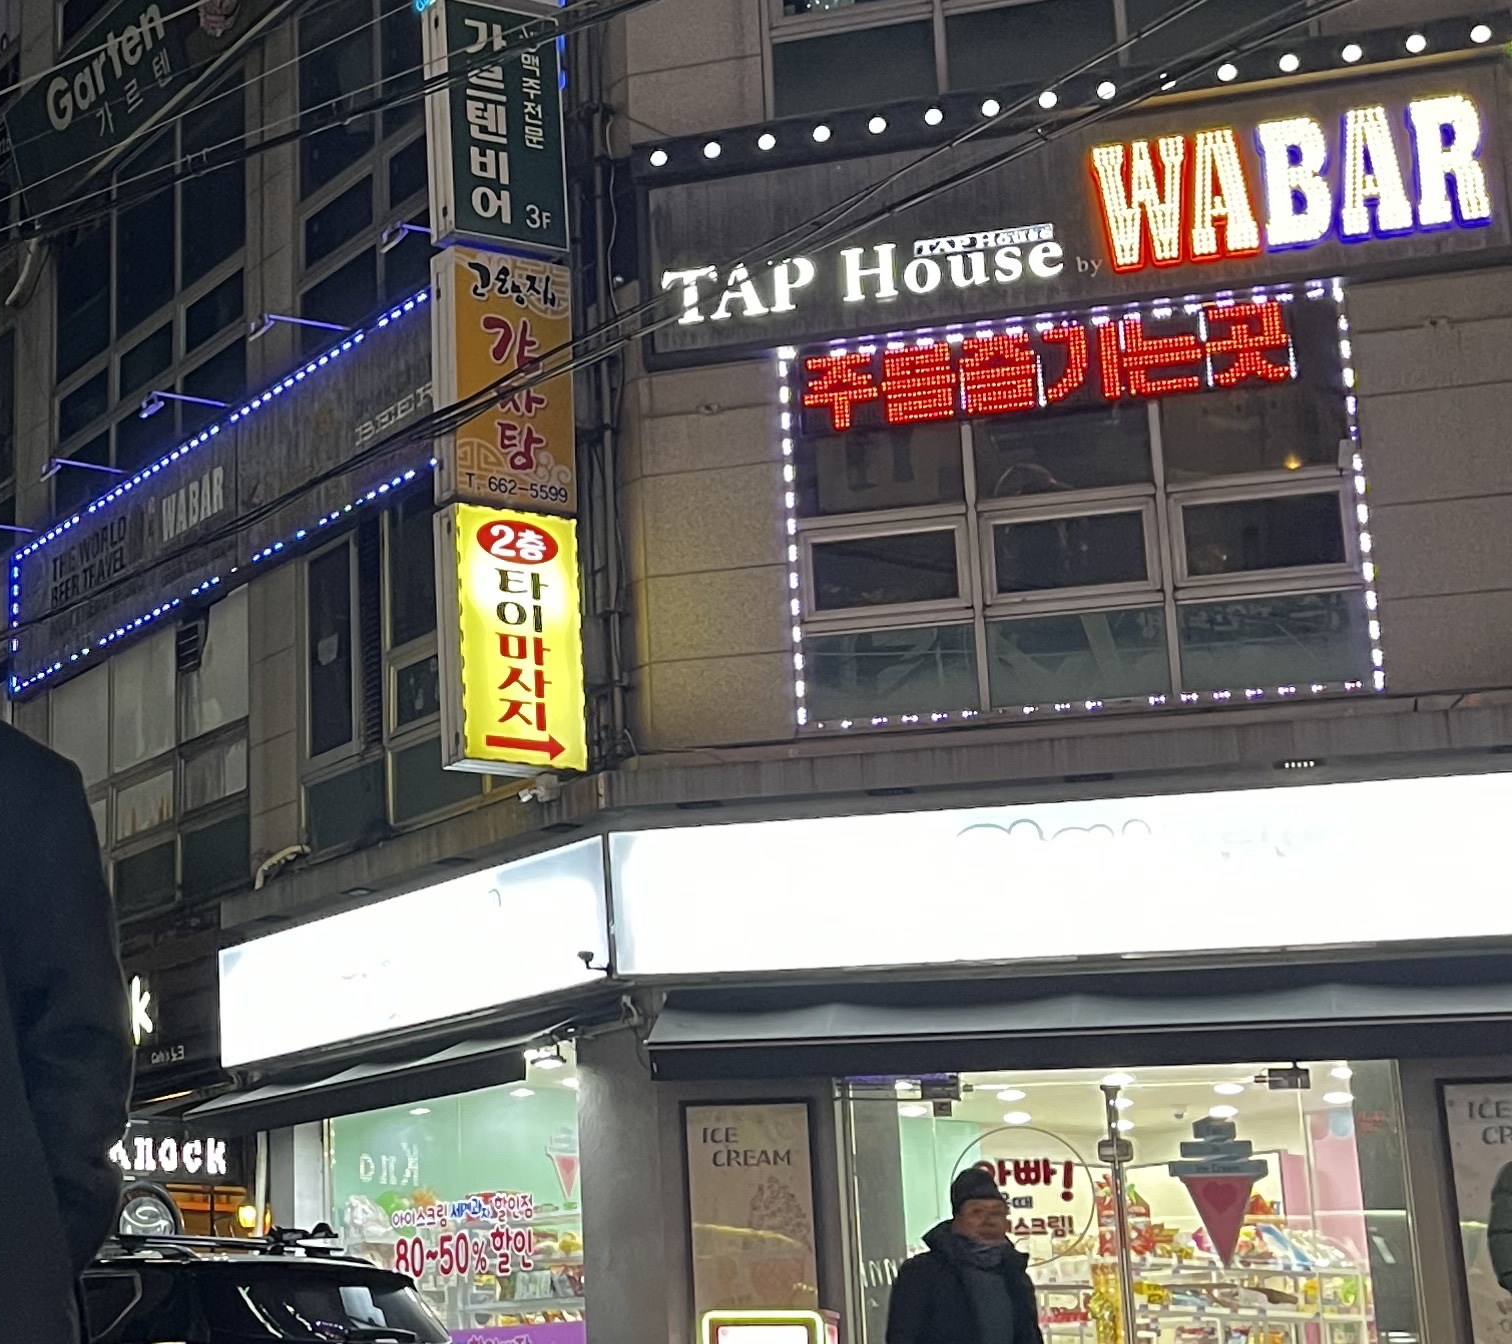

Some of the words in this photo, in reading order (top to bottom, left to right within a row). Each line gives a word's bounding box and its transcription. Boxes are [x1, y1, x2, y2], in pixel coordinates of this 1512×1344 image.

[45, 4, 165, 131] Garten
[1092, 93, 1493, 273] WABAR
[525, 204, 552, 230] 3F
[662, 258, 818, 326] TAP
[841, 241, 1064, 304] House
[1076, 257, 1103, 277] by
[162, 466, 225, 544] WABAR
[488, 476, 569, 505] 662-5599
[489, 524, 547, 562] 2층
[495, 567, 553, 733] 타이마사지
[703, 1127, 739, 1145] ICE
[712, 1149, 792, 1169] CREAM
[392, 1204, 449, 1228] 아이스크림
[395, 1231, 488, 1278] 80~50%
[491, 1227, 535, 1277] 할인
